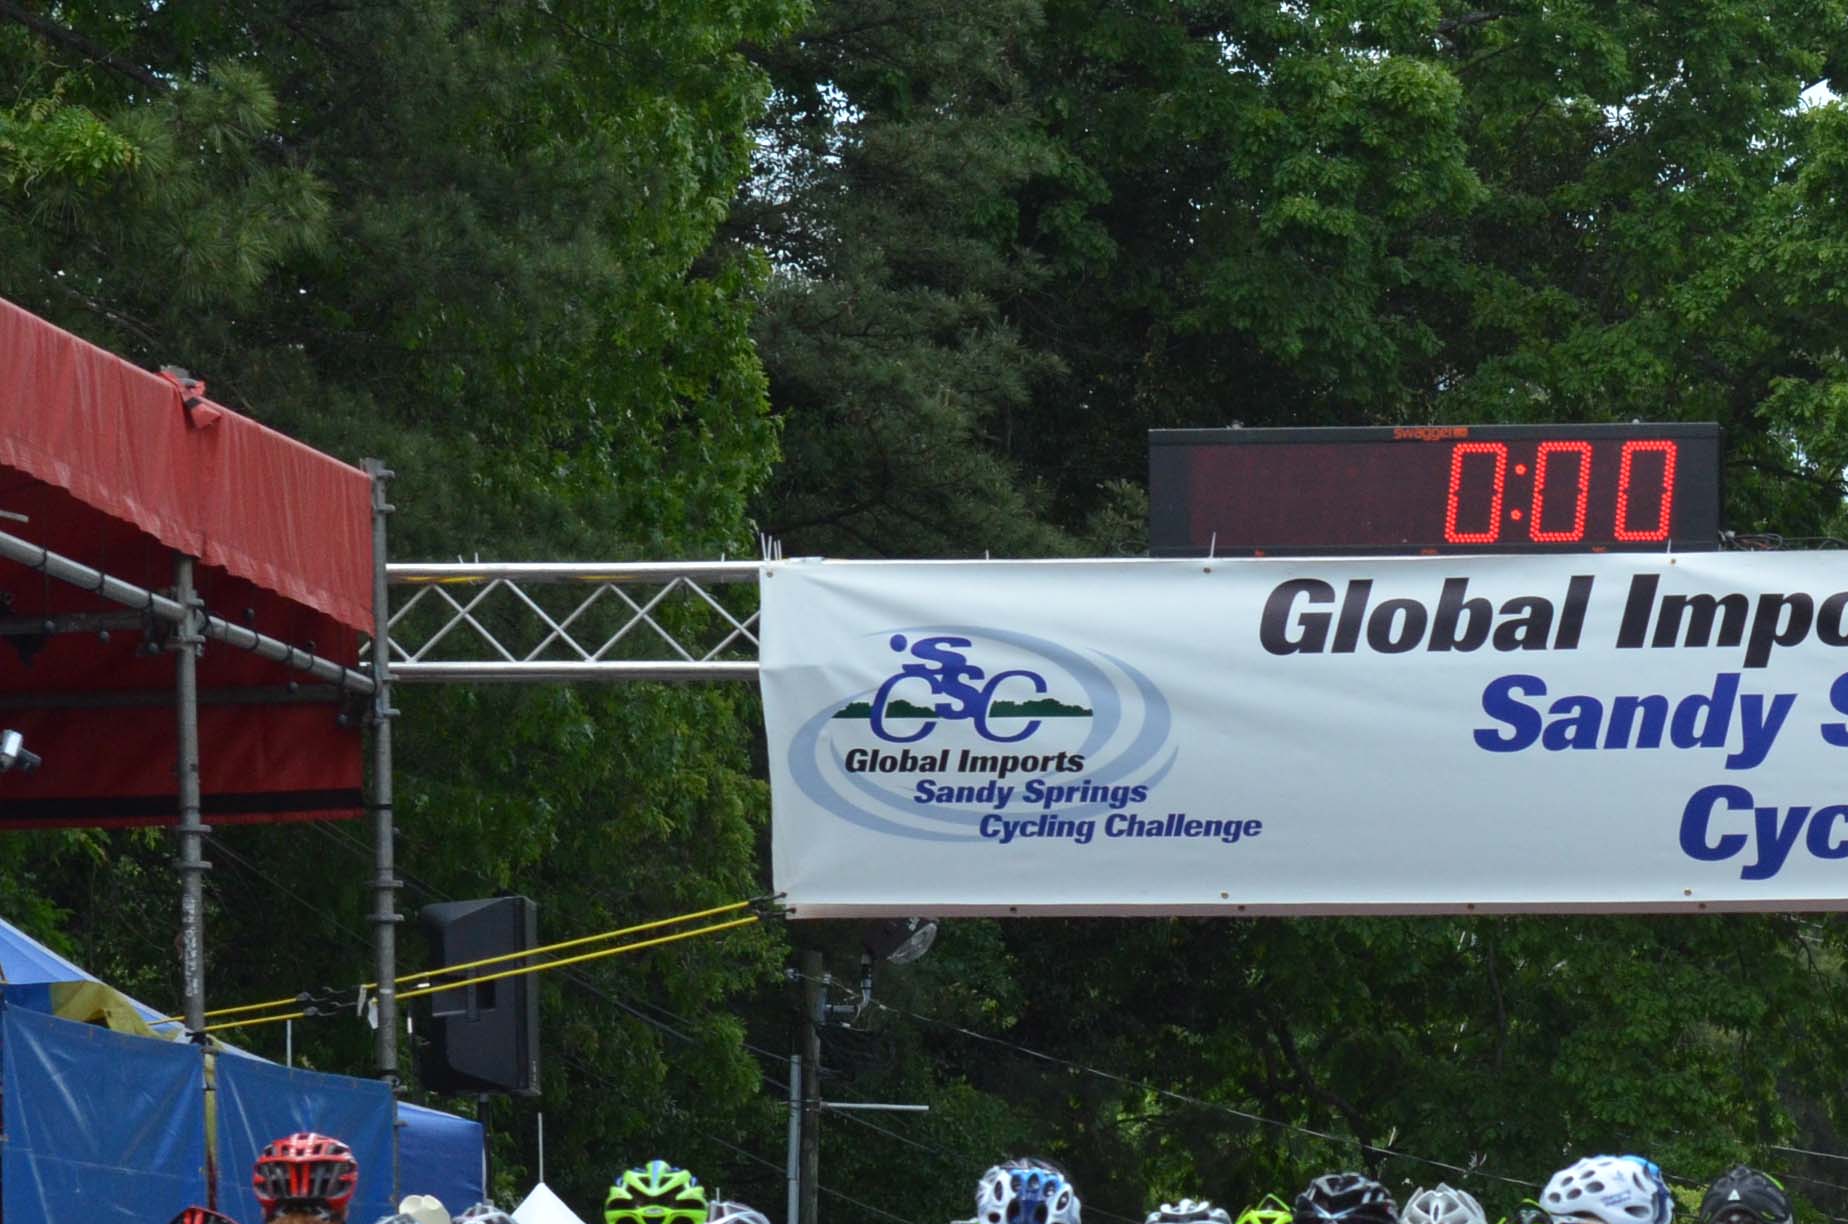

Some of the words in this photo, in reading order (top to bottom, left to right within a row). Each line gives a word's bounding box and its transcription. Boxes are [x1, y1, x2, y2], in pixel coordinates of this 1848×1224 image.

[1259, 576, 1594, 656] Global
[1474, 673, 1797, 769] Sandy
[845, 749, 949, 773] Global
[958, 750, 1084, 778] Imports
[914, 780, 1014, 809] Sandy
[1023, 780, 1148, 809] Springs
[980, 814, 1095, 844] Cycling
[1105, 813, 1263, 843] Challenge
